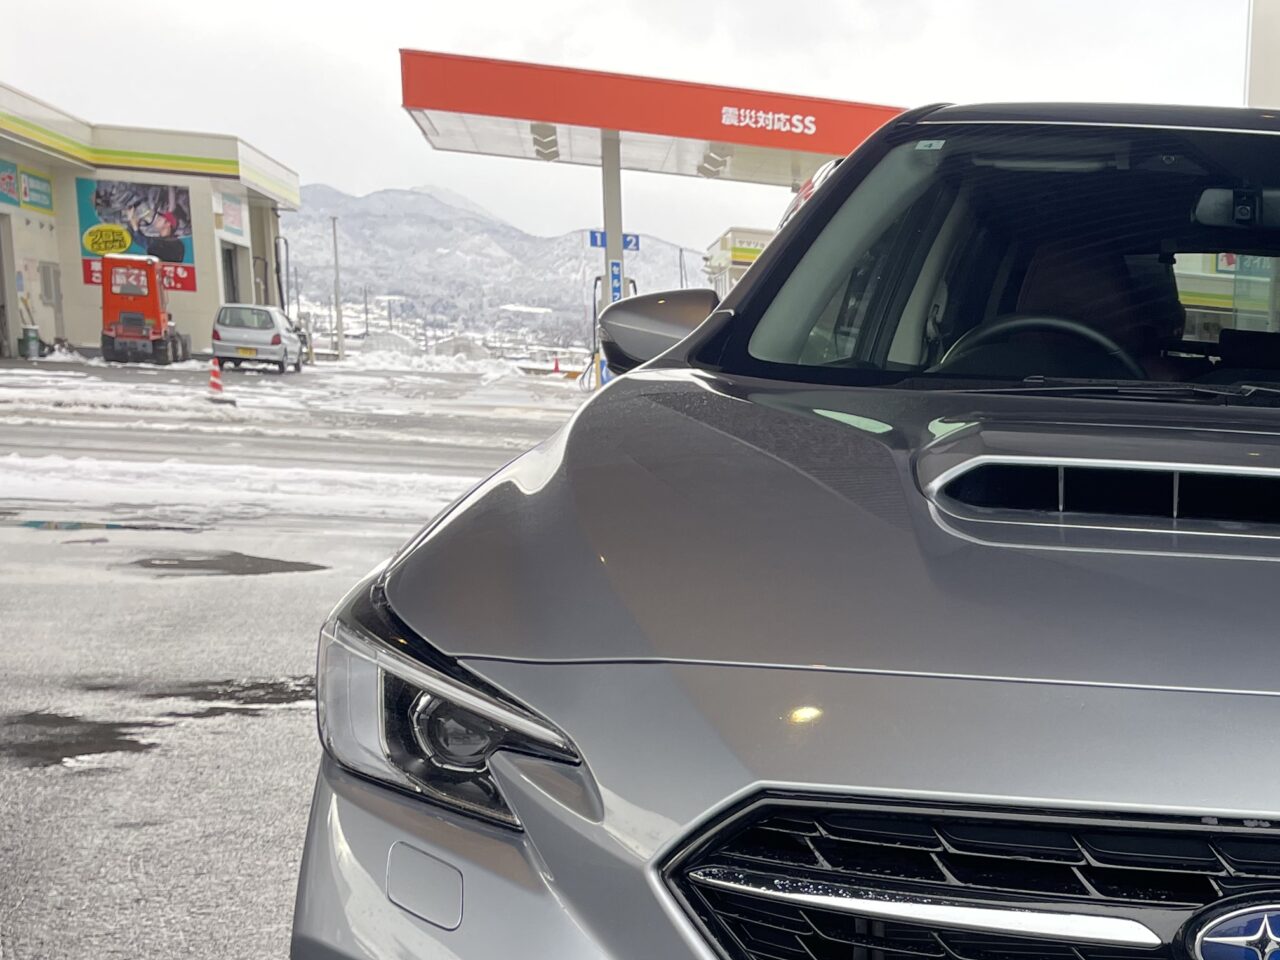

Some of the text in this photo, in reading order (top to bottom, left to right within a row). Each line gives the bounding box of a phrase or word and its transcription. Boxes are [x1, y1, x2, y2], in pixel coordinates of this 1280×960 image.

[721, 106, 817, 135] 震災対応SS
[595, 232, 602, 246] 1
[626, 236, 637, 250] 2
